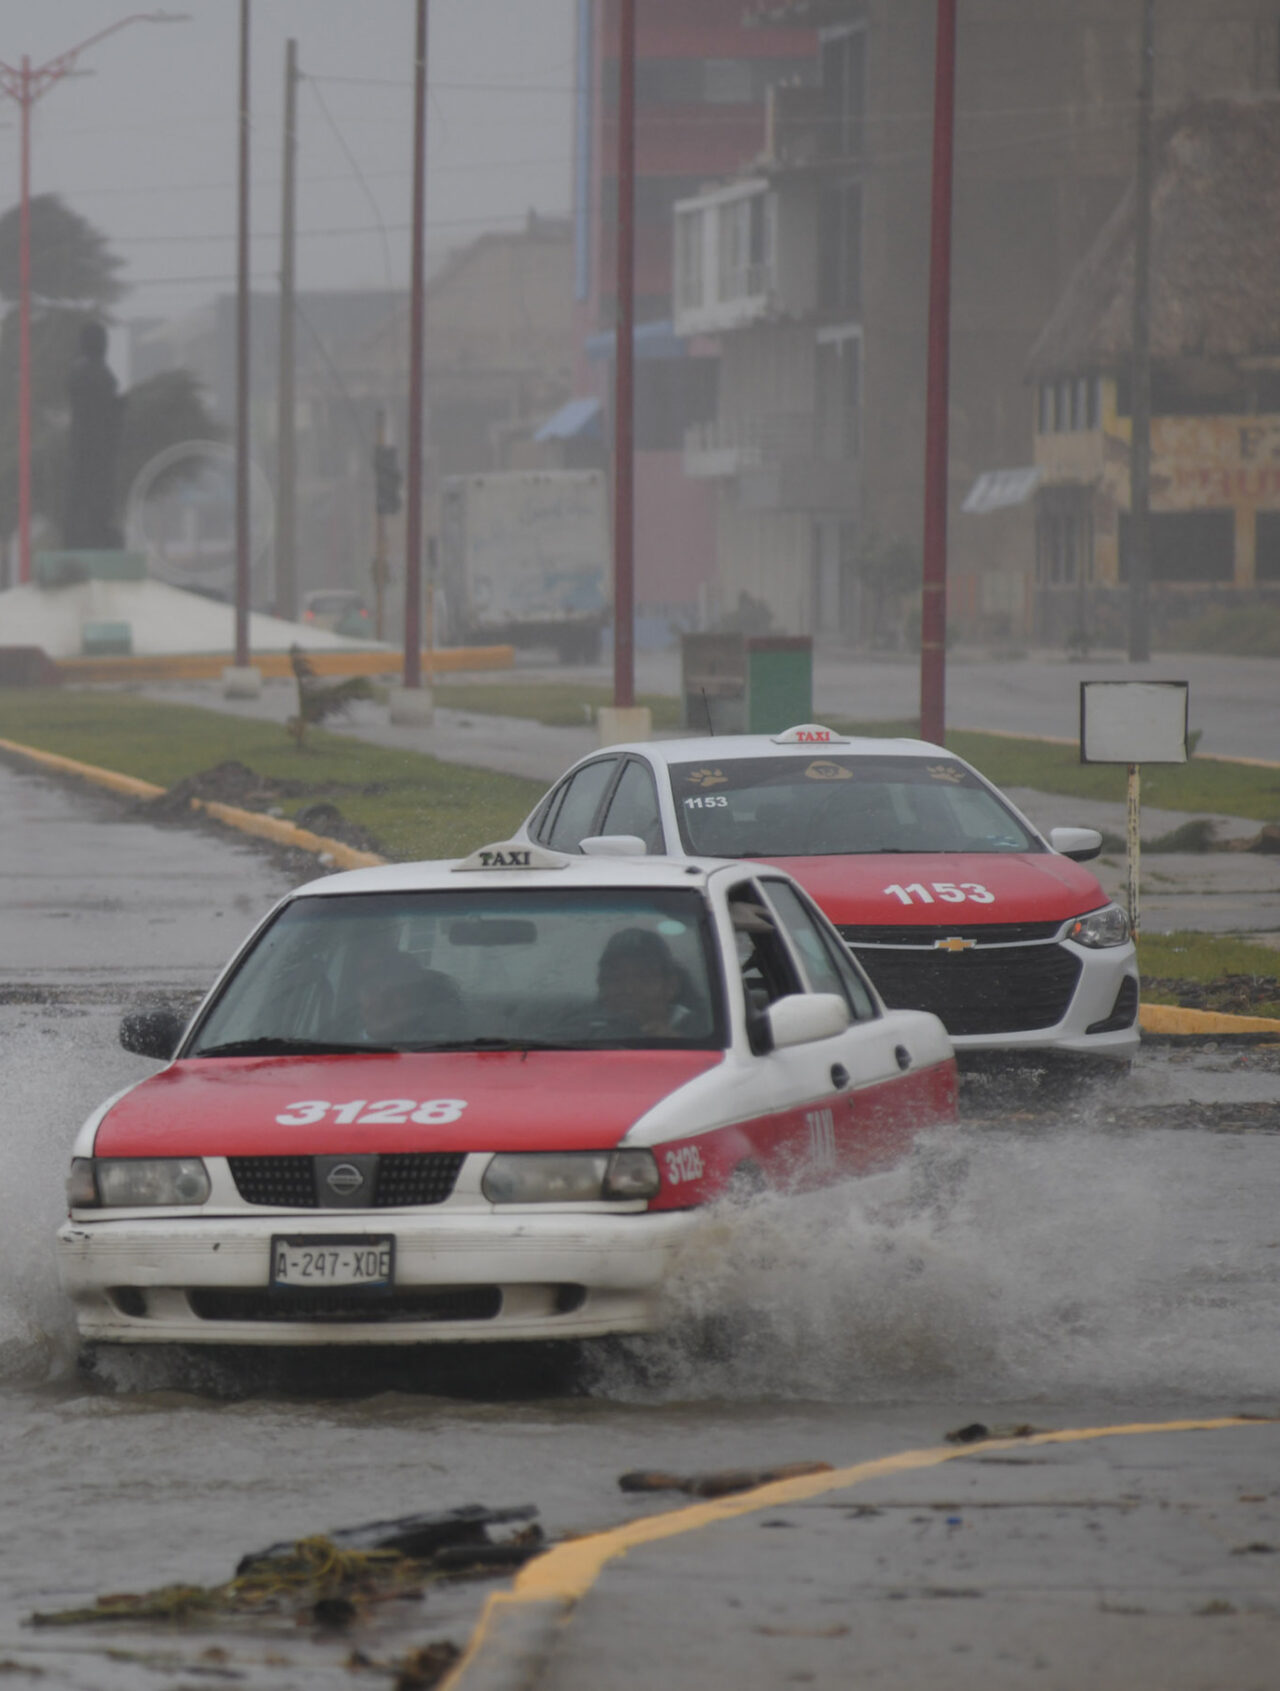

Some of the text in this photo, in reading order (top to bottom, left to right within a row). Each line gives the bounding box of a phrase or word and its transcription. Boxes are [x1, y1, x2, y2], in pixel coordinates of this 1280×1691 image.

[795, 731, 830, 742] TAXI
[684, 796, 728, 809] 1153
[479, 851, 531, 867] TAXI
[883, 882, 996, 905] 1153
[275, 1098, 468, 1126] 3128
[666, 1145, 704, 1185] 3128
[276, 1251, 390, 1278] A-247-XDE
